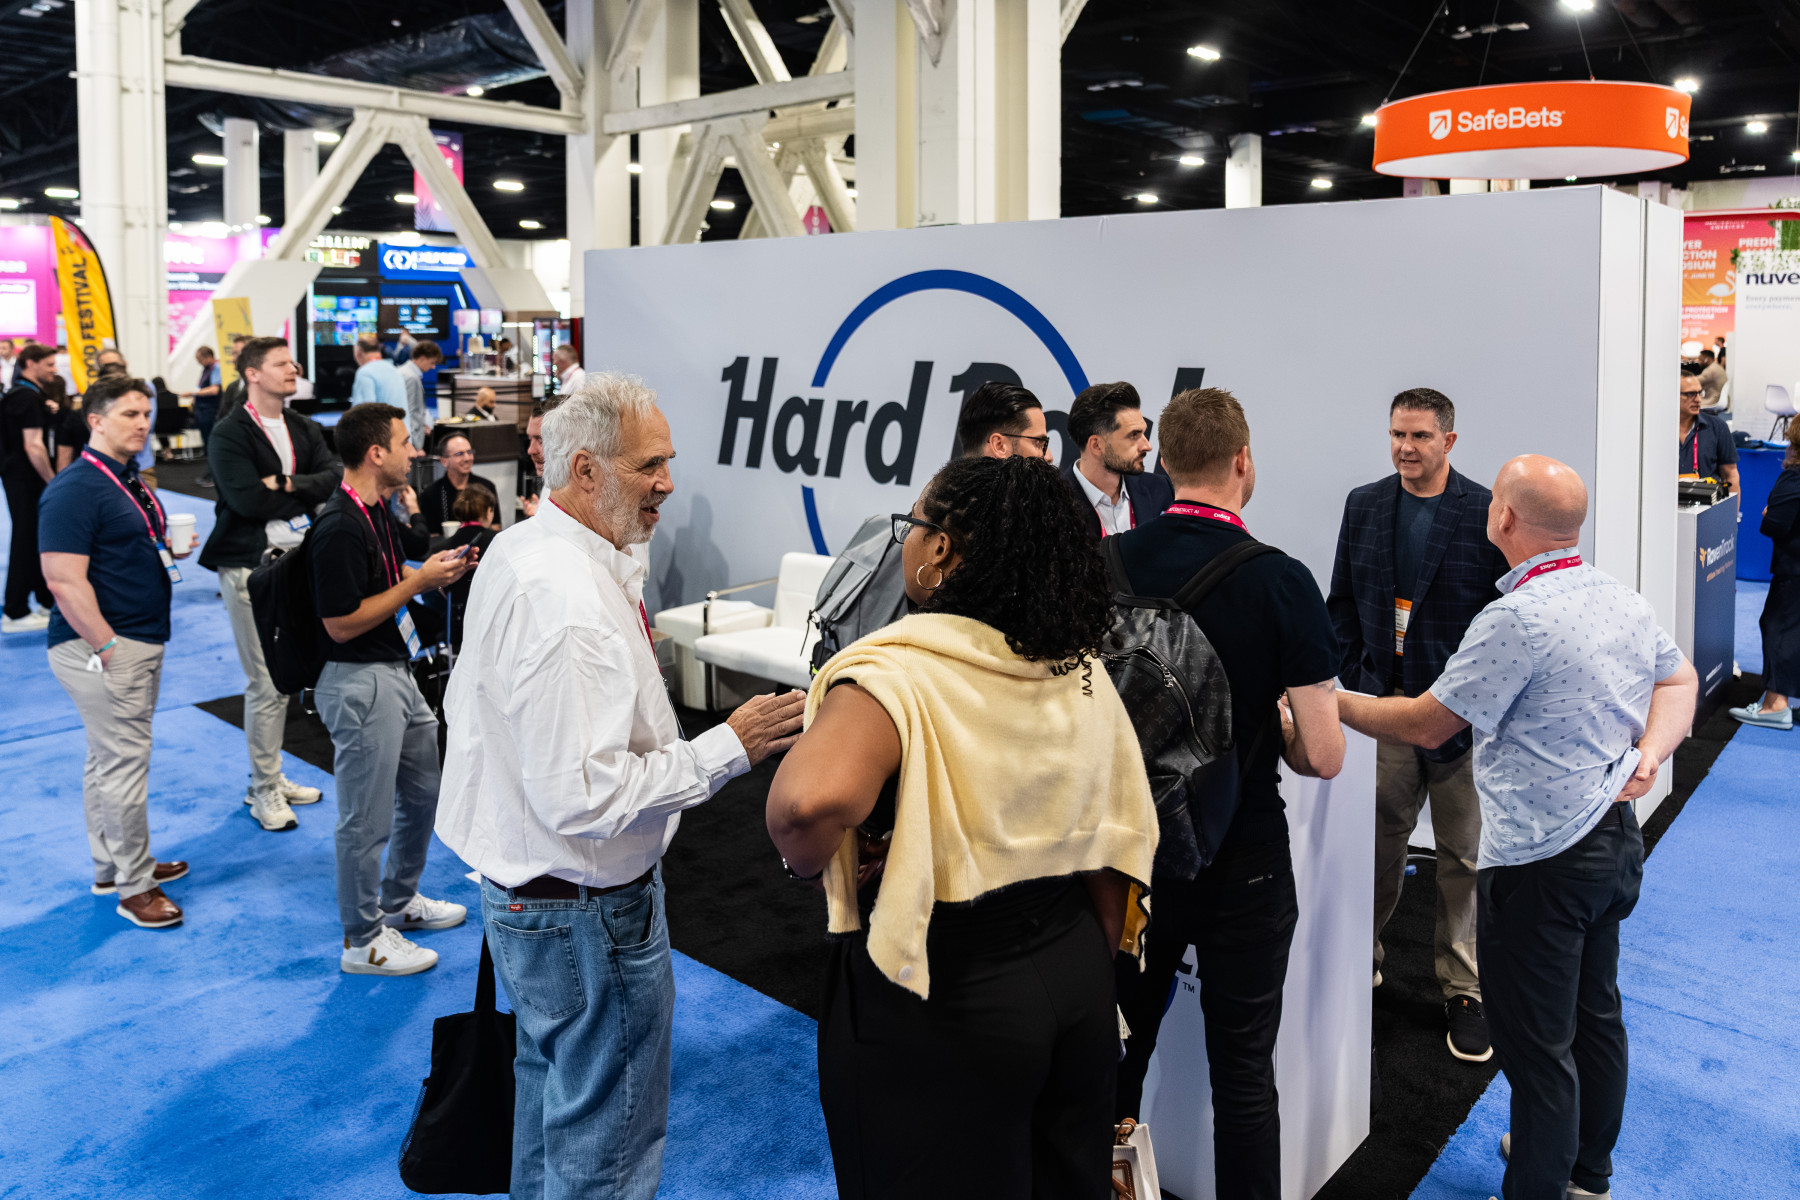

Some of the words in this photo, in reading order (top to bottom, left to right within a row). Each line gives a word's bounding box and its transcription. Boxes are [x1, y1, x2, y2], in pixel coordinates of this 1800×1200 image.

[1457, 106, 1563, 133] SafeBets
[72, 257, 95, 340] FESTIVAL
[718, 356, 934, 486] Hard
[1183, 981, 1196, 994] TM
